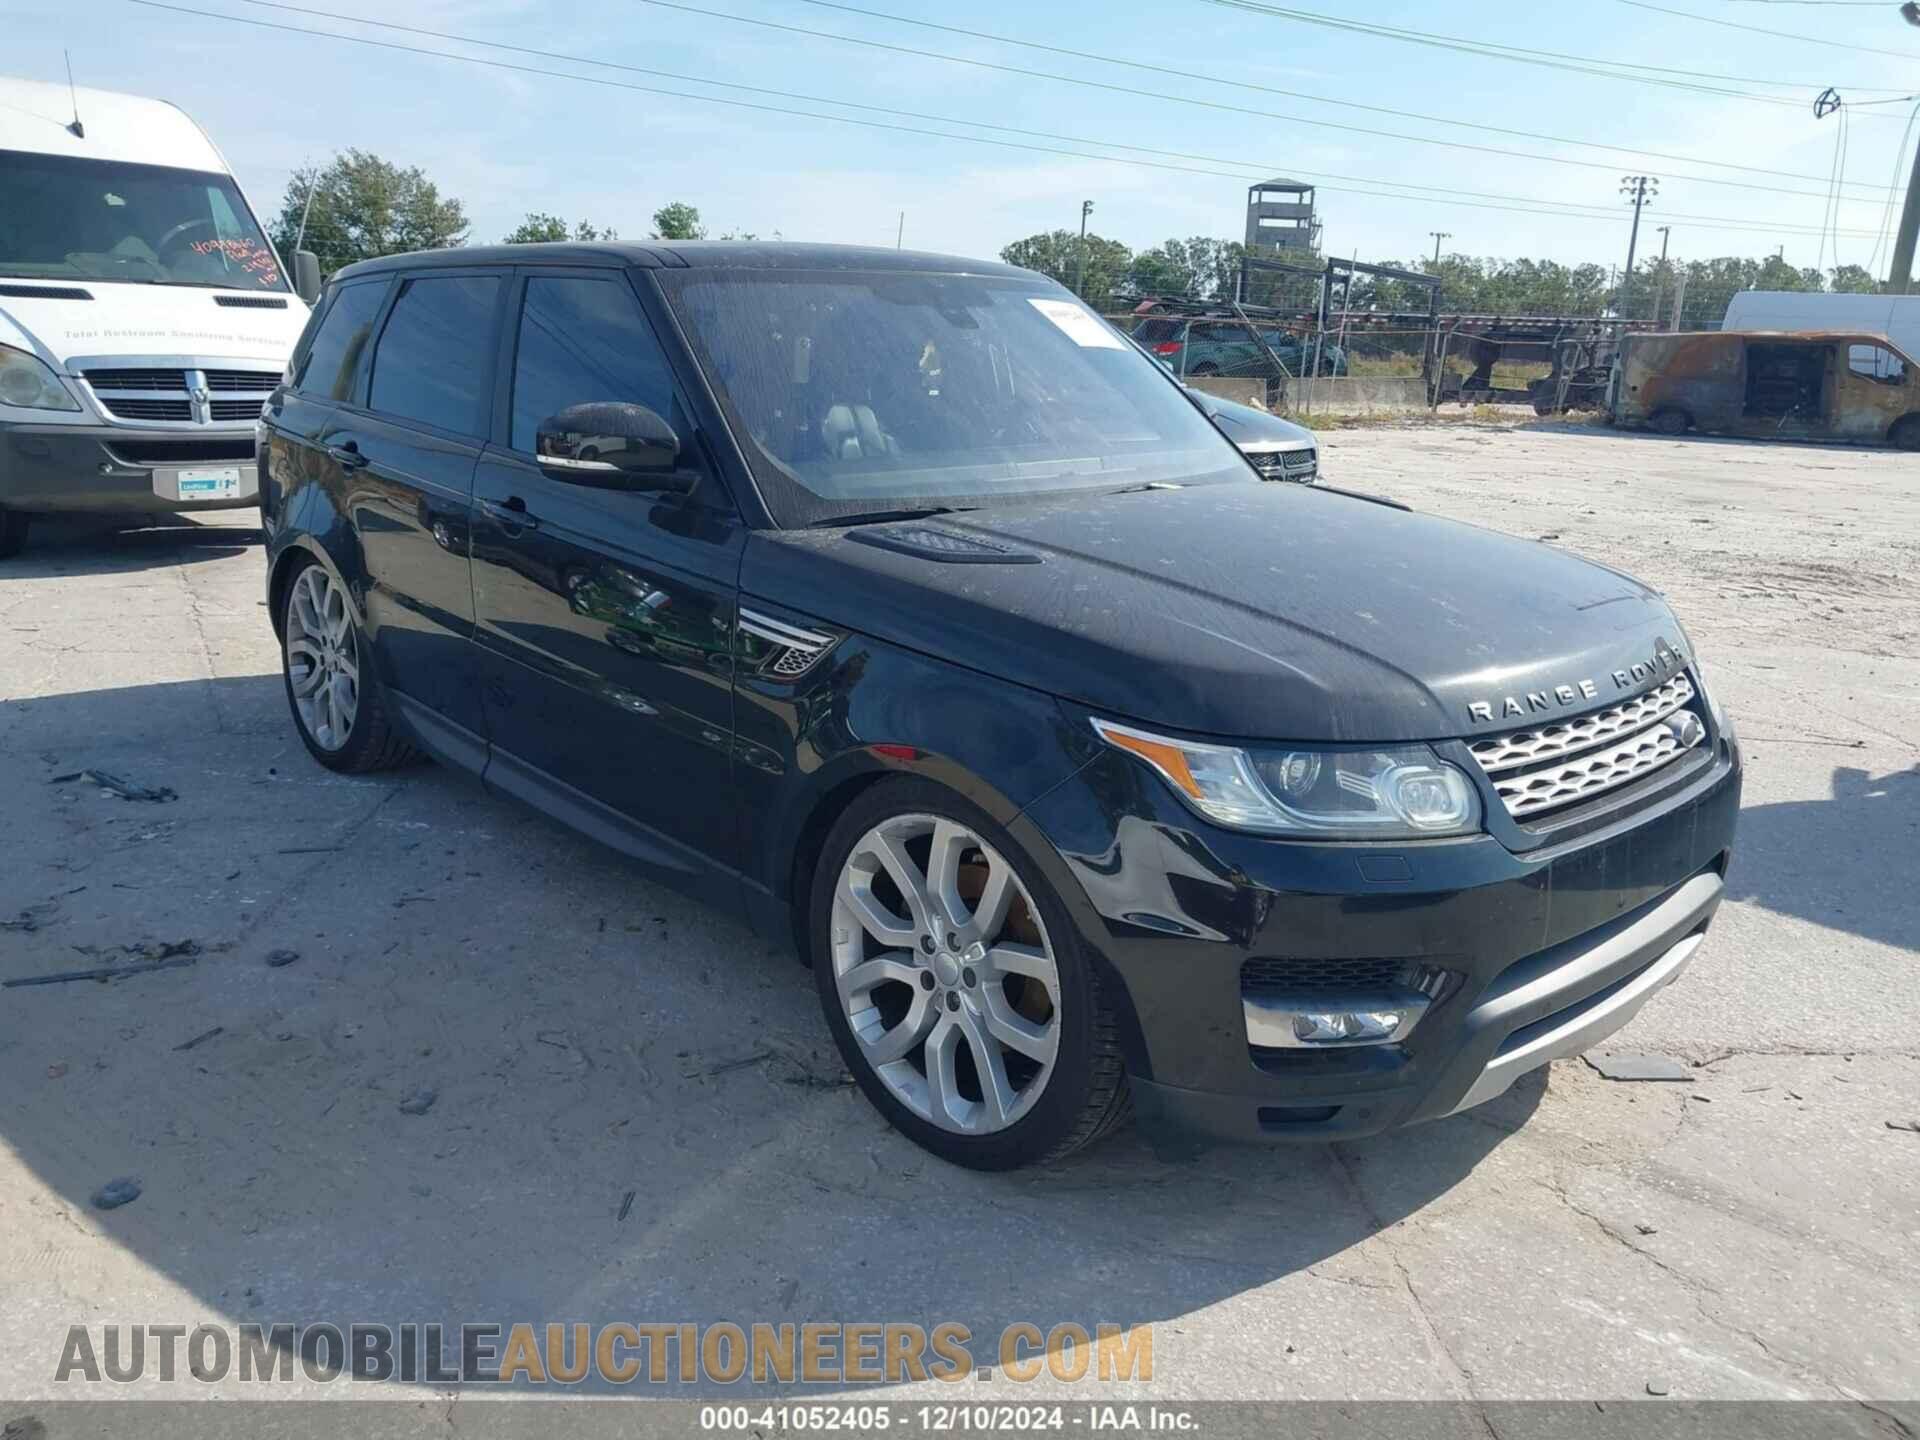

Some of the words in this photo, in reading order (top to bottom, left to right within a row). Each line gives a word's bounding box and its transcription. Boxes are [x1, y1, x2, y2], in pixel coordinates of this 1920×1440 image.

[64, 329, 97, 340] Total
[1467, 679, 1598, 724] RANGE
[1611, 646, 1683, 690] ROVER
